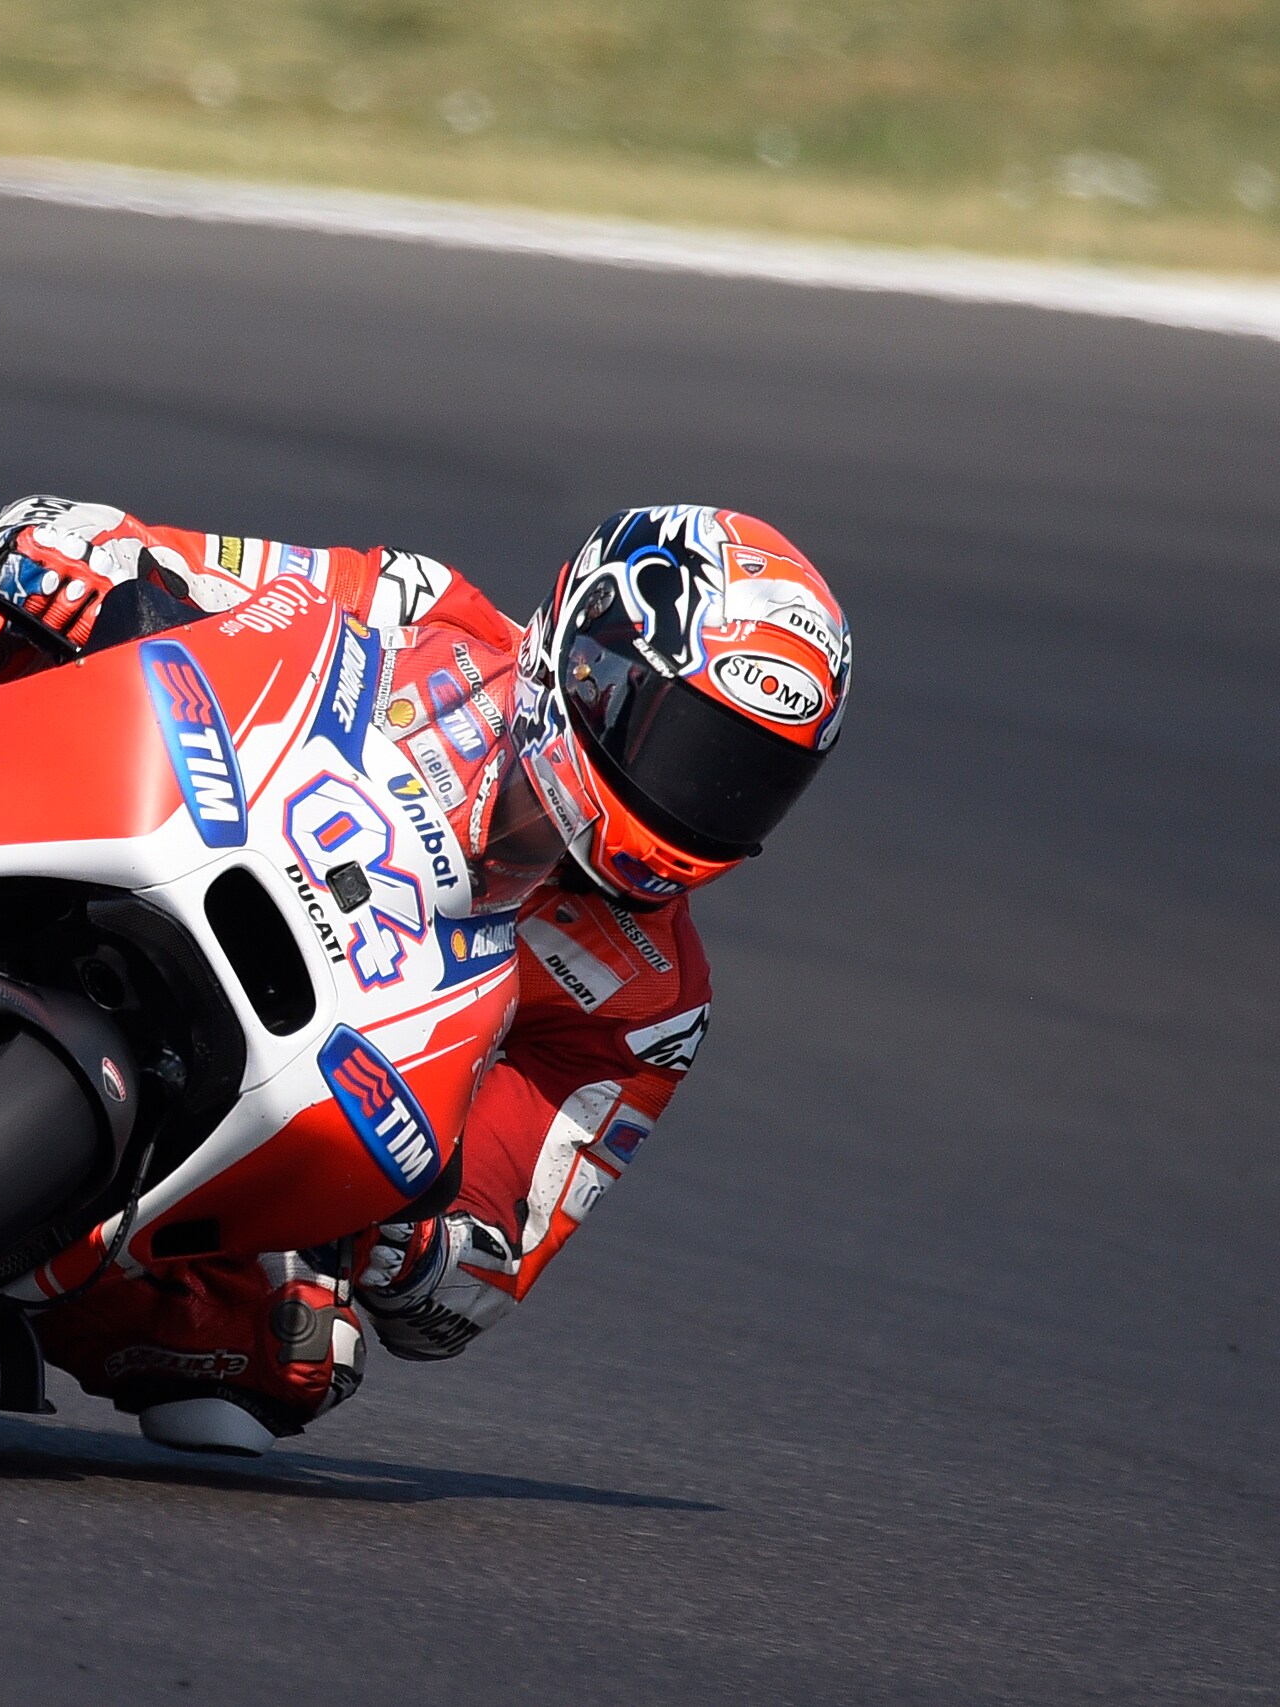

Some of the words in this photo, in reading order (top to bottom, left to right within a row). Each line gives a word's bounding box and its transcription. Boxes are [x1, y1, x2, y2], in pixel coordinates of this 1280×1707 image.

[727, 655, 818, 720] SUOMY
[443, 708, 483, 752] TIM
[176, 728, 240, 823] TIM
[421, 748, 454, 794] riello
[545, 786, 575, 834] DUCATI
[283, 862, 348, 965] DUCATI
[545, 954, 597, 1006] DUCATI
[374, 1096, 434, 1184] TIM
